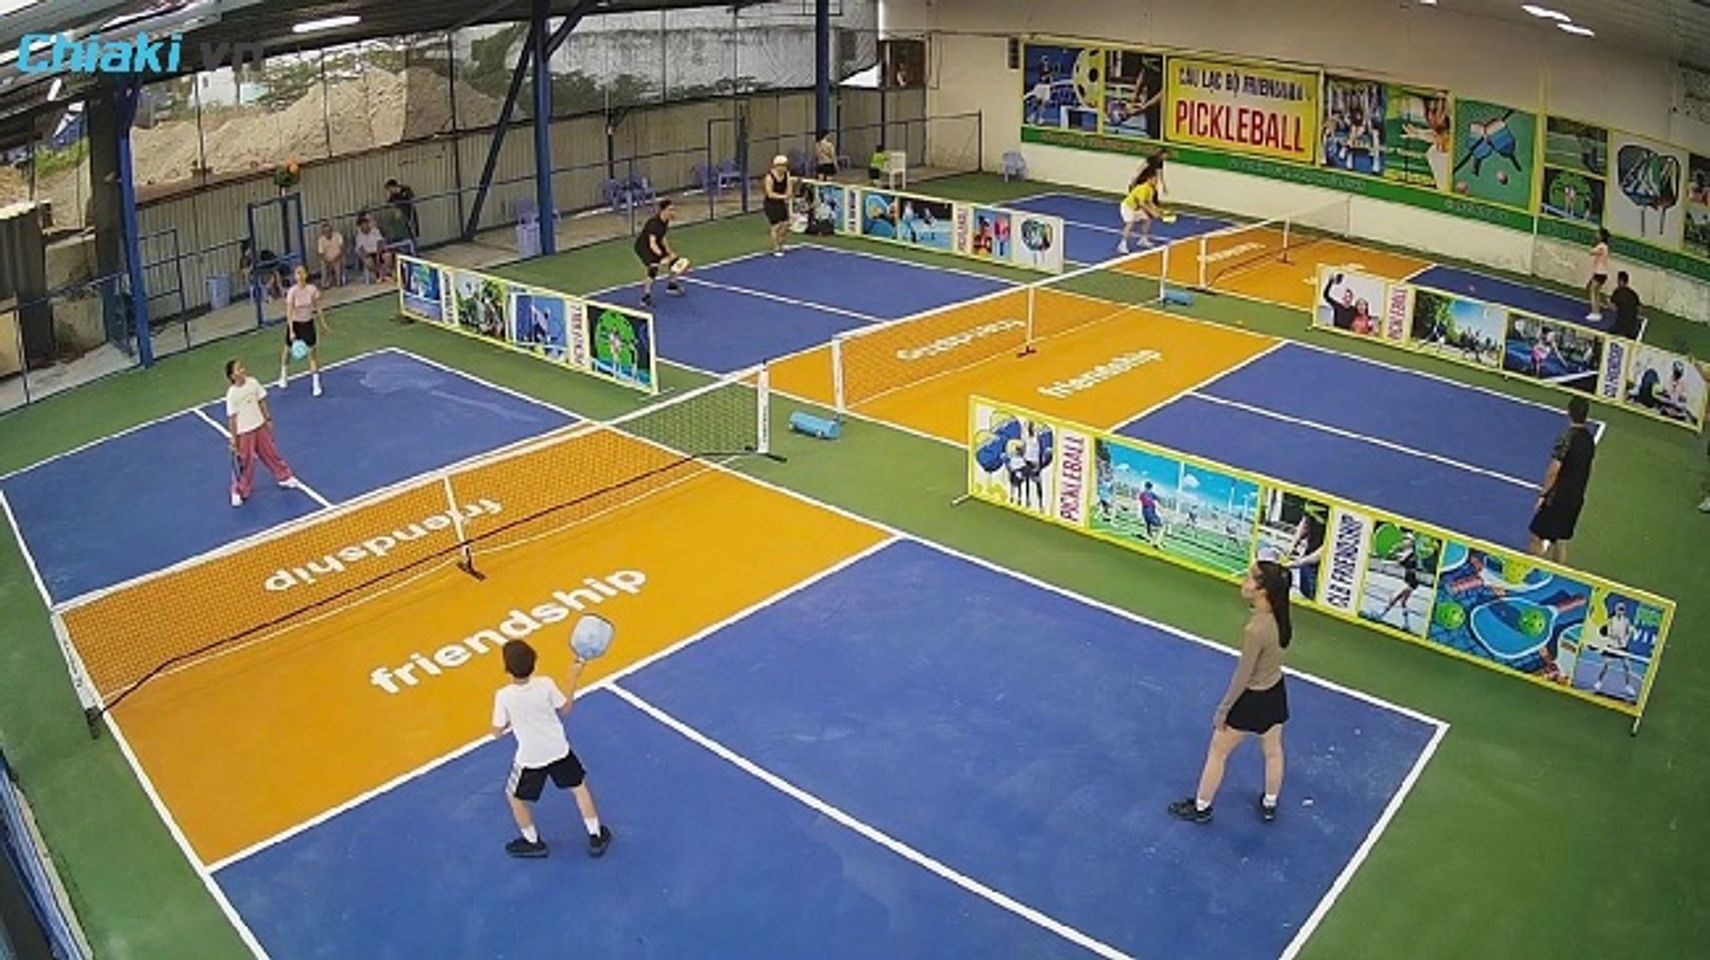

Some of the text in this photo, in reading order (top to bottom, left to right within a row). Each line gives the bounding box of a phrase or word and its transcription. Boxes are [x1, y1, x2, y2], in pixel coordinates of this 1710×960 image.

[1175, 99, 1305, 153] PICKLEBALL
[1060, 436, 1084, 521] PICKLEBALL
[264, 498, 502, 592] friendship
[370, 568, 647, 694] friendship
